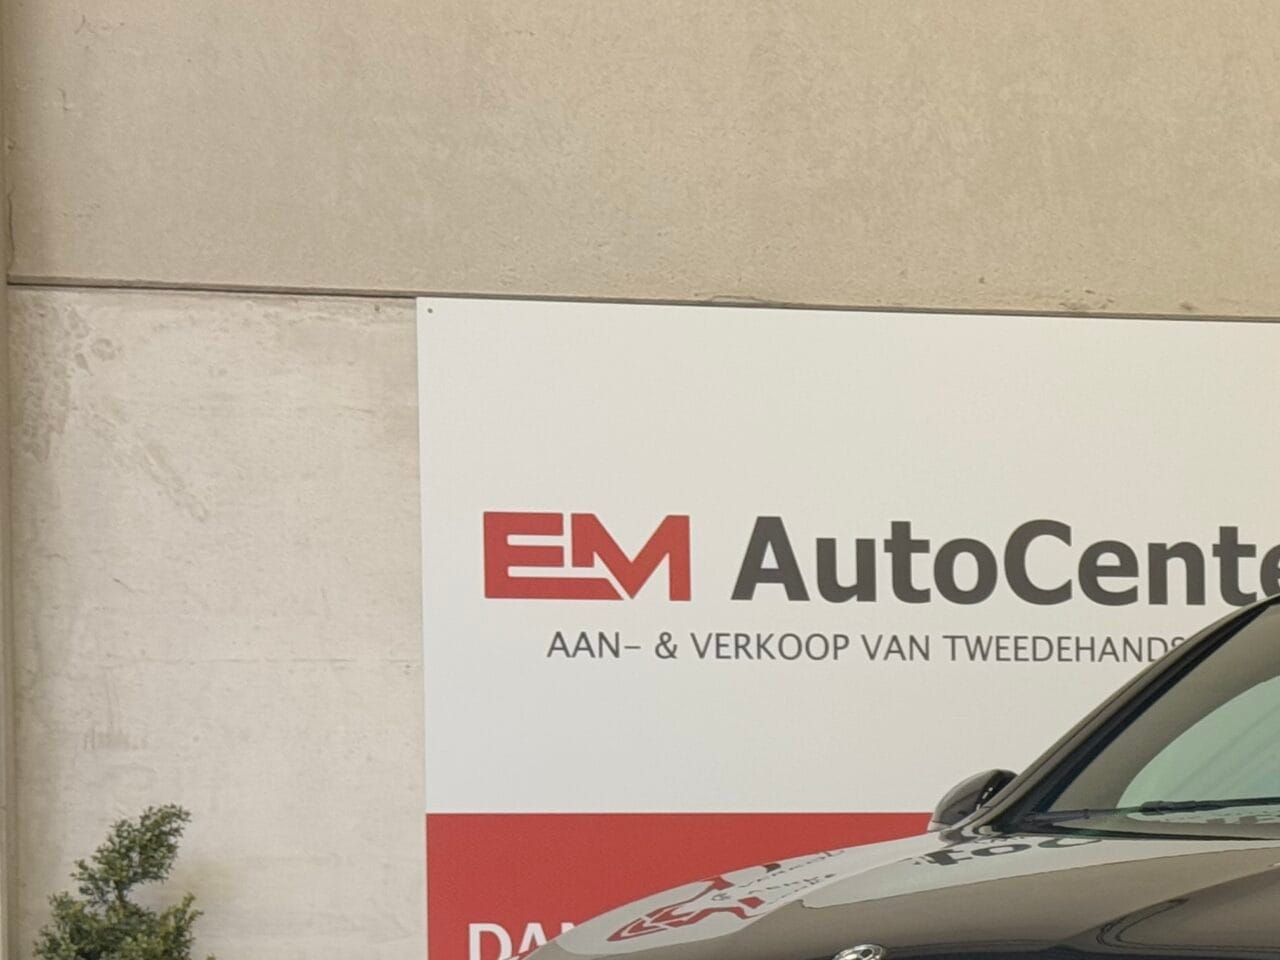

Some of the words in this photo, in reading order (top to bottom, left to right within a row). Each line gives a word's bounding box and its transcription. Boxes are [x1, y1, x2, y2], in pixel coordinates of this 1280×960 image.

[483, 511, 691, 601] EM
[655, 632, 679, 660] &
[691, 632, 849, 661] VERKOOP
[862, 634, 930, 661] VAN
